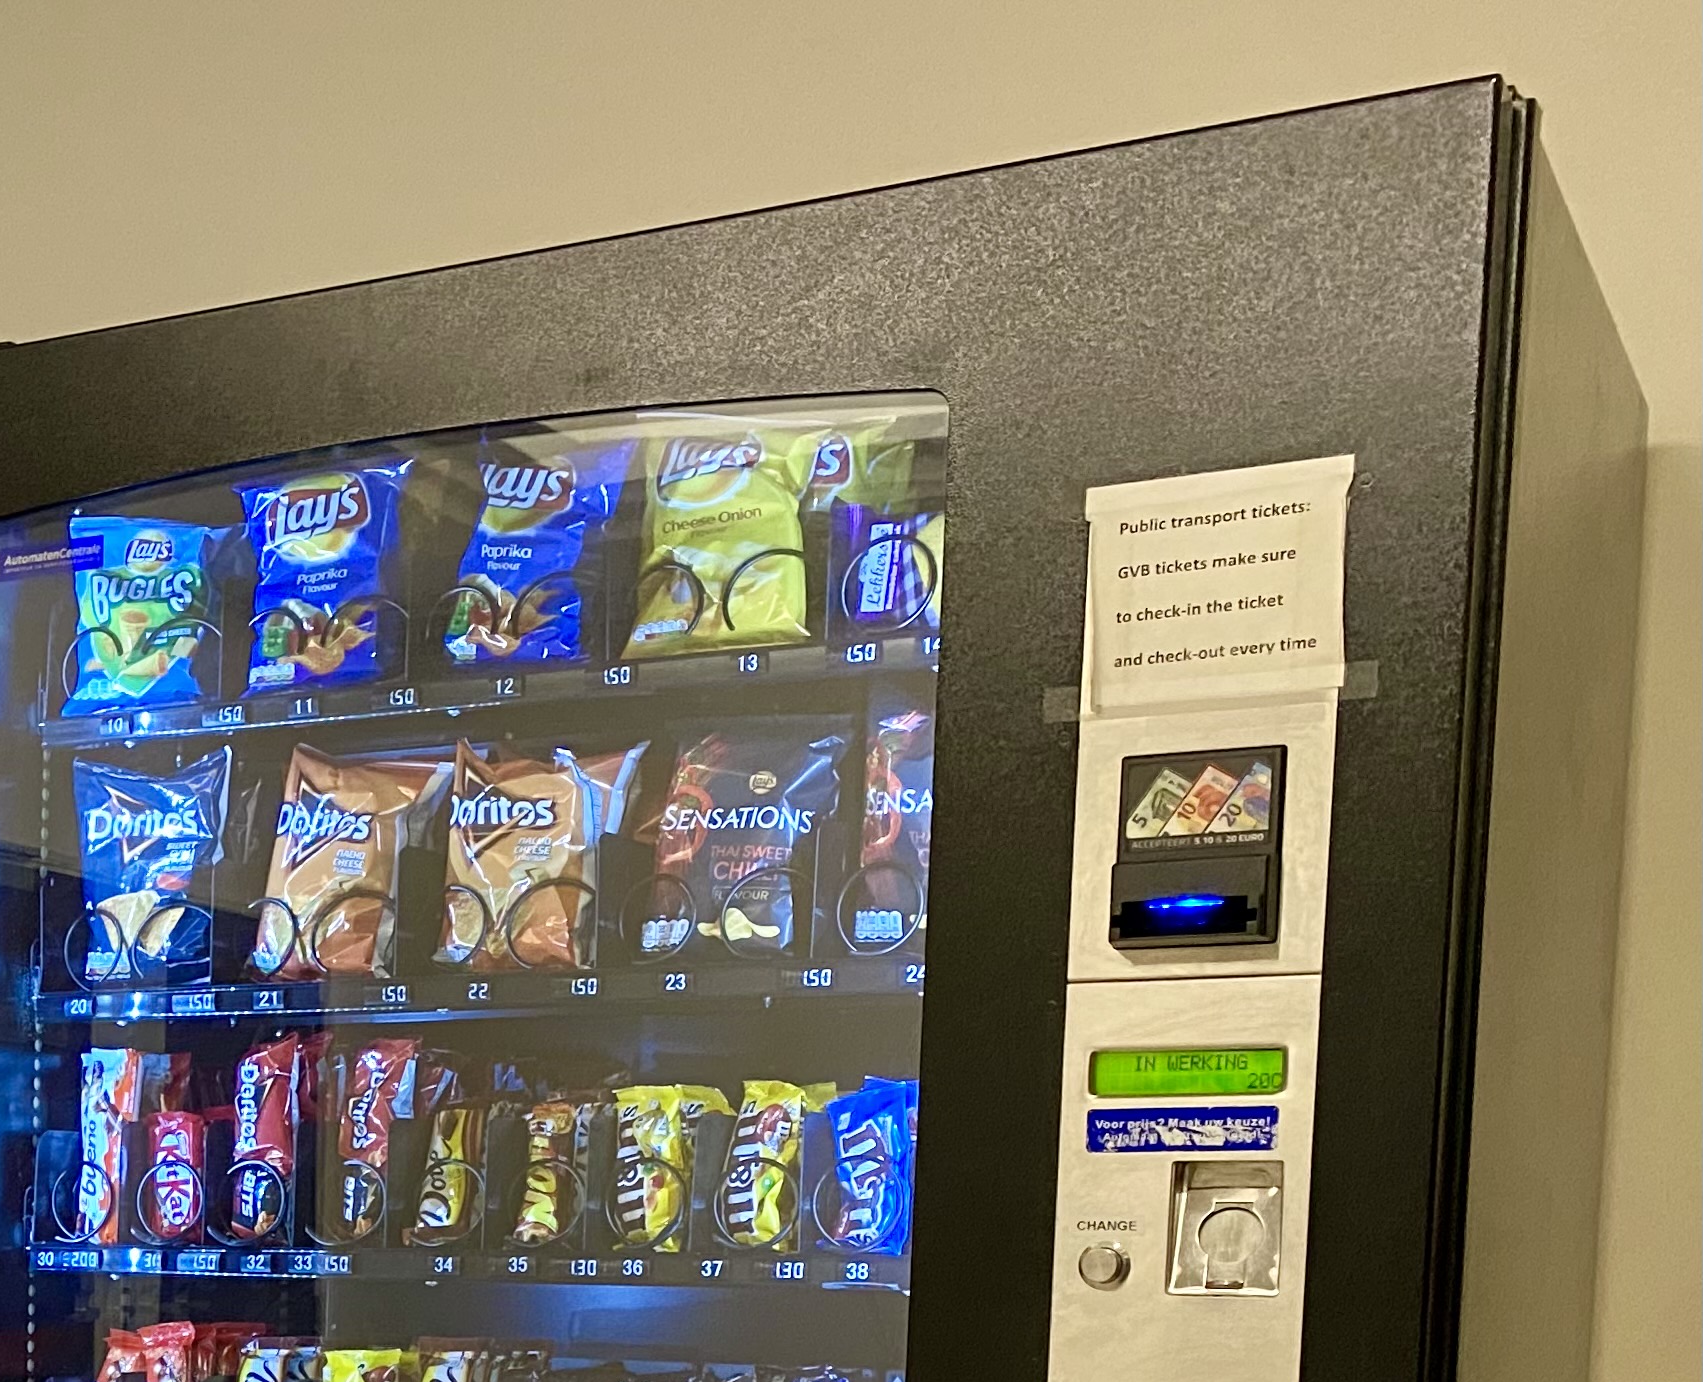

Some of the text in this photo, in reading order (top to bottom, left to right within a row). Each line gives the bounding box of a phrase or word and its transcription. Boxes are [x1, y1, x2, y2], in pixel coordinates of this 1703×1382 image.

[662, 517, 713, 535] Cheese
[716, 505, 762, 524] Onion
[1119, 502, 1311, 535] Public transport tickets:
[481, 544, 532, 562] Paprika
[1118, 548, 1297, 579] GVB tickets make sure
[297, 567, 347, 586] Paprika
[303, 581, 338, 595] Flavour
[92, 571, 193, 623] BUGLES
[1116, 594, 1284, 624] to check-in the ticket
[1114, 636, 1318, 668] and check-out every time
[108, 718, 122, 733] 10
[295, 698, 312, 715] 11
[497, 678, 514, 694] 12
[738, 654, 758, 671] 13
[661, 805, 814, 834] SENSATIONS
[1132, 814, 1147, 829] 5
[1176, 802, 1197, 822] 10
[1218, 802, 1243, 827] 20
[1239, 833, 1264, 842] EURO
[743, 845, 792, 860] SWEET
[71, 1000, 86, 1014] 20
[259, 992, 279, 1007] 21
[468, 983, 488, 1000] 22
[666, 974, 686, 991] 23
[1135, 1054, 1249, 1071] IN WERKING
[236, 1064, 260, 1149] Doritos
[1095, 1120, 1125, 1129] Voor
[239, 1169, 258, 1218] BITS
[1077, 1220, 1137, 1232] CHANGE
[37, 1253, 54, 1266] 30
[247, 1255, 265, 1269] 32
[294, 1256, 312, 1270] 33
[434, 1257, 453, 1273] 34
[508, 1257, 528, 1273] 35
[622, 1260, 643, 1276] 36
[701, 1261, 723, 1277] 37
[846, 1263, 869, 1280] 38
